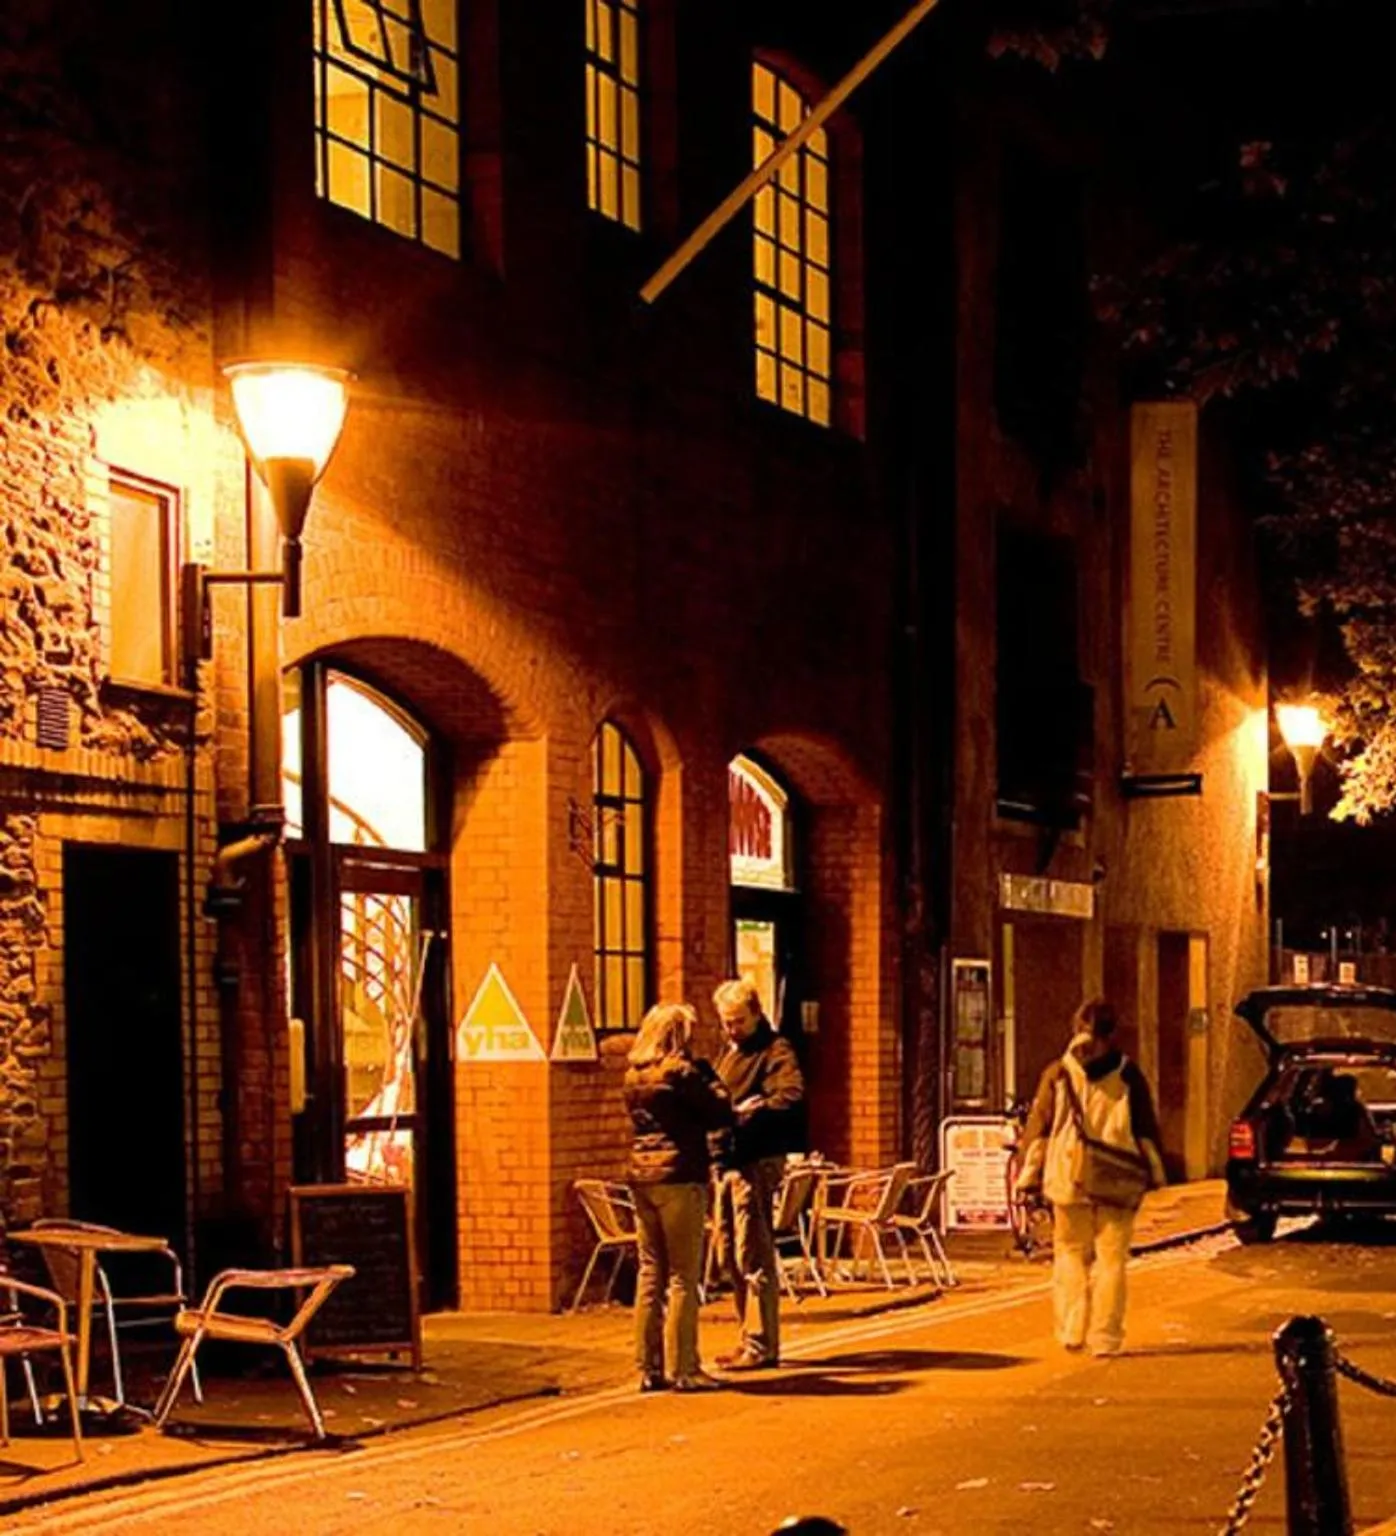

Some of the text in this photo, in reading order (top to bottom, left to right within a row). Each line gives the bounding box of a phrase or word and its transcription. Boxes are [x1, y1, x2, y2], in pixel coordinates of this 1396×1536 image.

[1154, 429, 1172, 663] THE ARCHITECTURE CENTRE
[1149, 697, 1177, 730] A
[463, 1025, 531, 1056] yha
